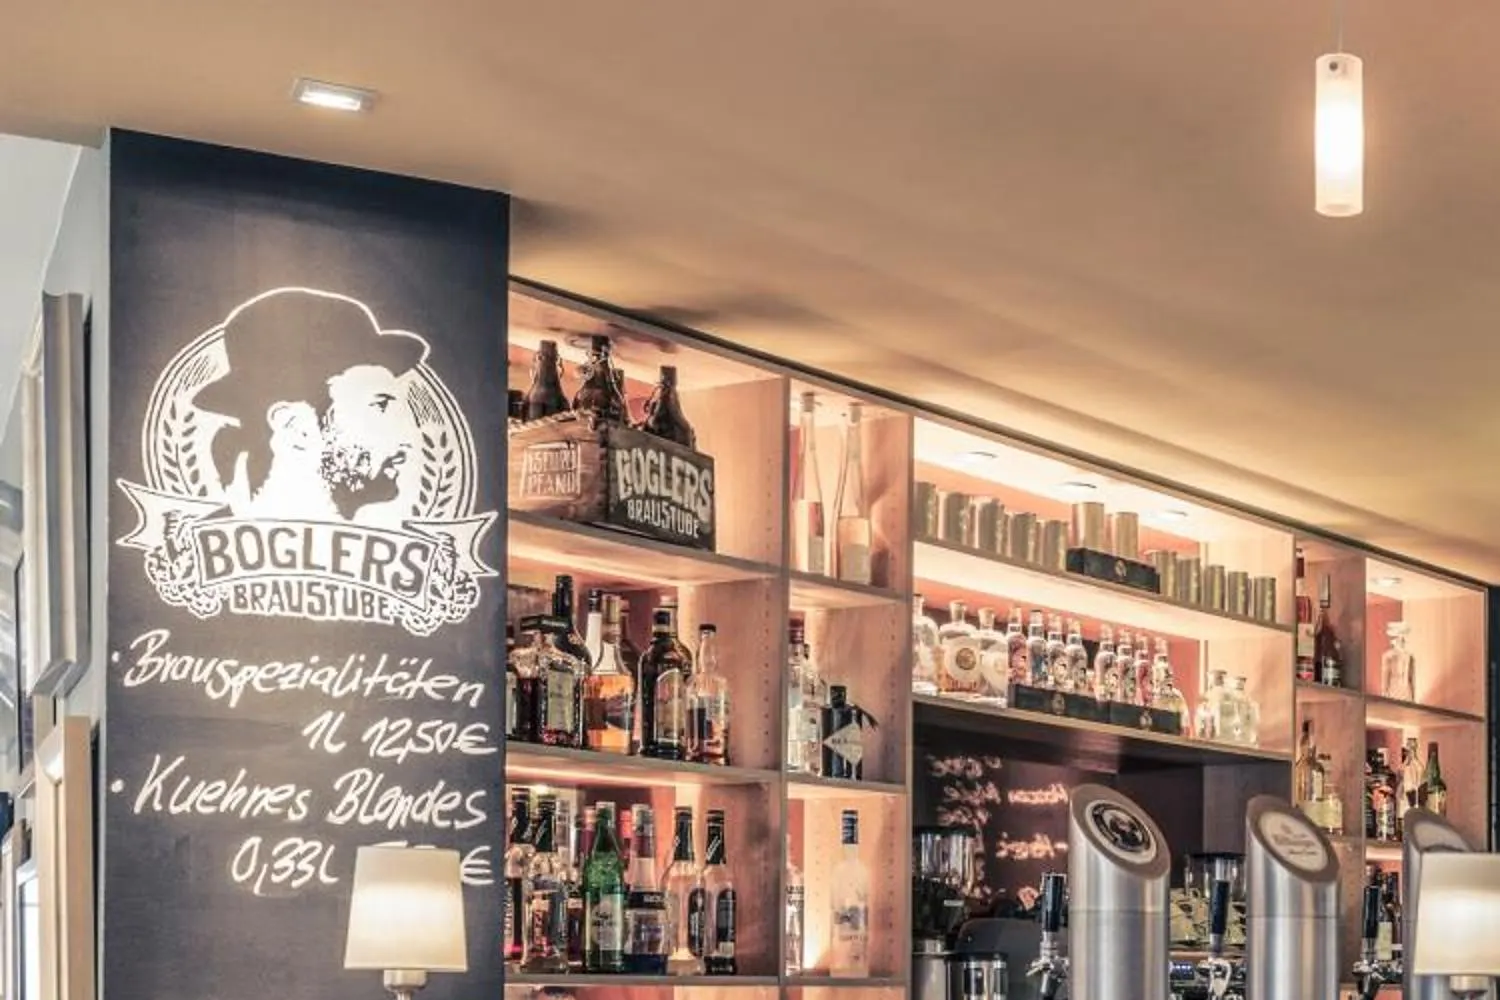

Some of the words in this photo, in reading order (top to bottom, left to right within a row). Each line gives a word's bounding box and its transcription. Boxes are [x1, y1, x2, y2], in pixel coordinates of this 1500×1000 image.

[615, 447, 714, 523] BOGLERS
[627, 499, 699, 539] BRAUSTUBE
[198, 524, 434, 599] BOGLERS
[234, 579, 392, 621] BRAUSTUBE
[124, 629, 485, 707] Brauspezialitäten
[302, 710, 345, 754] 1L
[362, 717, 498, 764] 12,50€
[133, 754, 311, 823] Kuehnes
[326, 768, 487, 830] Blondes
[230, 836, 340, 896] 0,33L
